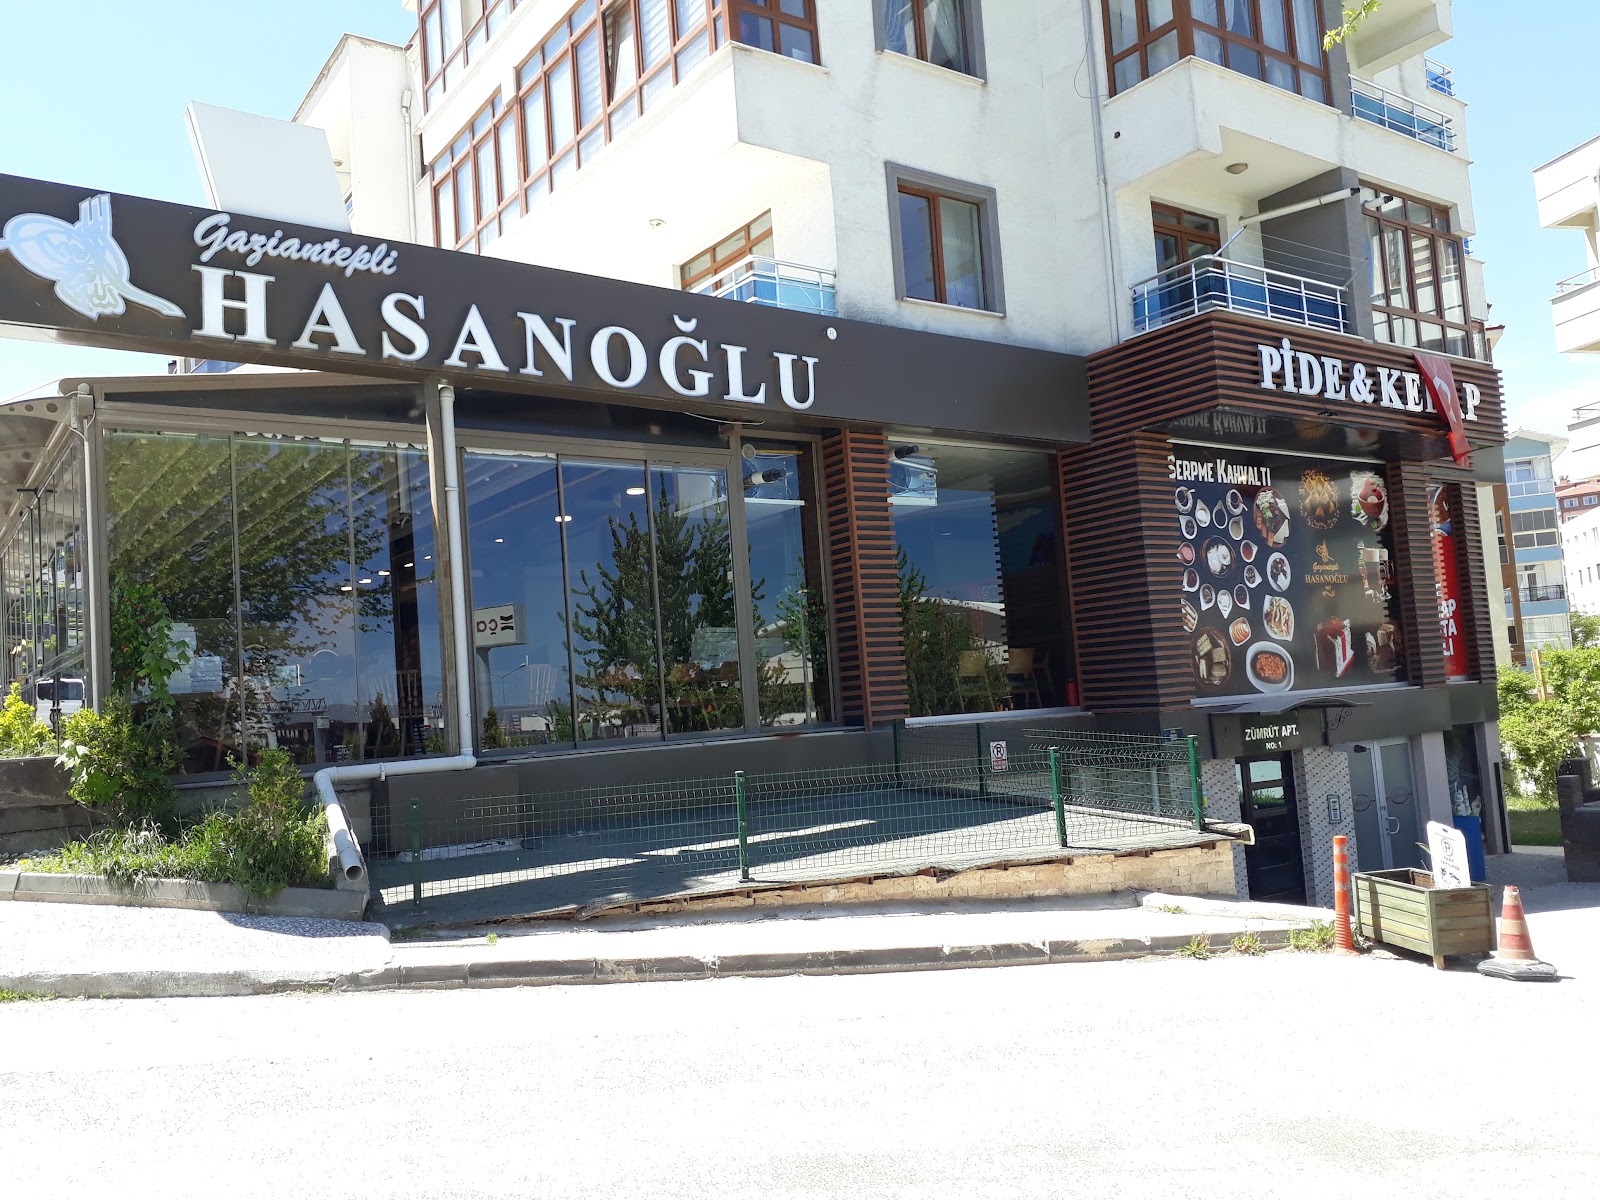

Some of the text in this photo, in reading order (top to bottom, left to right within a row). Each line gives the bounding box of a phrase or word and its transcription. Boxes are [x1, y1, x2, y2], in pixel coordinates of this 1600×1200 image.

[194, 213, 399, 278] Gaziantepli
[191, 264, 819, 410] HASANOĞLU
[1257, 338, 1481, 421] PİDE&KEP
[1216, 459, 1271, 486] KAHVALTI
[1305, 573, 1349, 583] HASANOĞLU
[1244, 724, 1299, 741] ZÜMRÜT APT.
[1265, 741, 1282, 750] NO: 1
